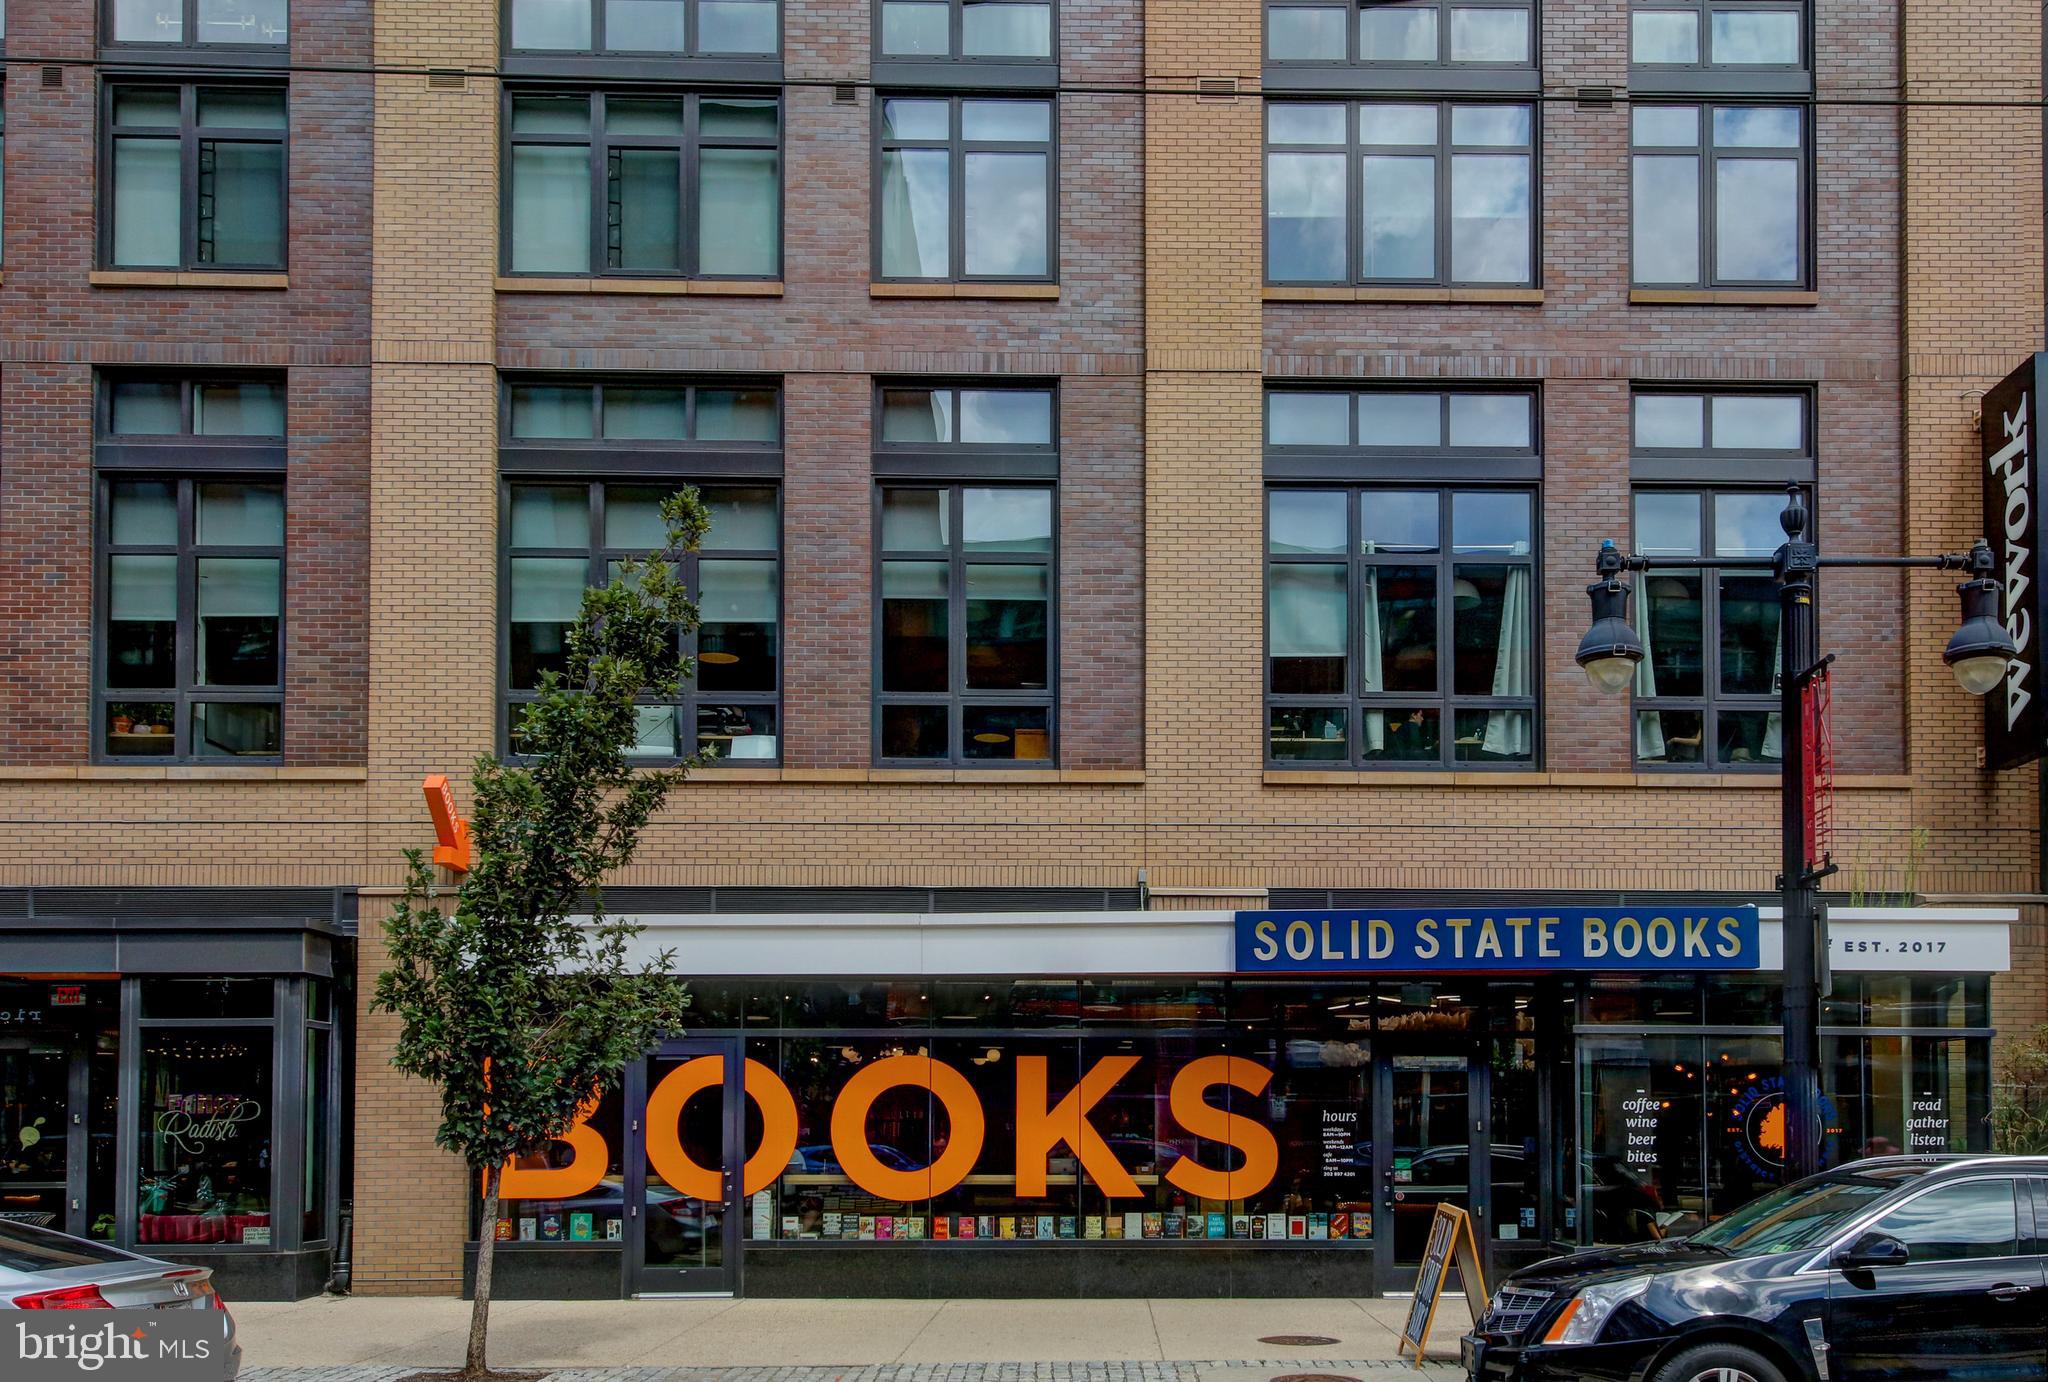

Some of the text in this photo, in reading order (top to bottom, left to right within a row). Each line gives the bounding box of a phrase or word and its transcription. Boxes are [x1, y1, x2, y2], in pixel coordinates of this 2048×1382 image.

[1989, 391, 2031, 732] wework
[441, 782, 460, 833] BOOKS
[1253, 917, 1741, 961] SOLID STATE BOOKS
[1844, 940, 1948, 953] EST. 2017
[1622, 1098, 1660, 1114] coffee
[1912, 1098, 1942, 1111] read
[1322, 1109, 1358, 1122] hours
[1625, 1115, 1657, 1127] wine
[158, 1101, 260, 1154] Radish
[482, 1055, 1278, 1201] BOOKS
[1906, 1116, 1949, 1131] gather
[1628, 1132, 1656, 1145] beer
[1910, 1133, 1945, 1146] listen
[1627, 1150, 1658, 1163] bites
